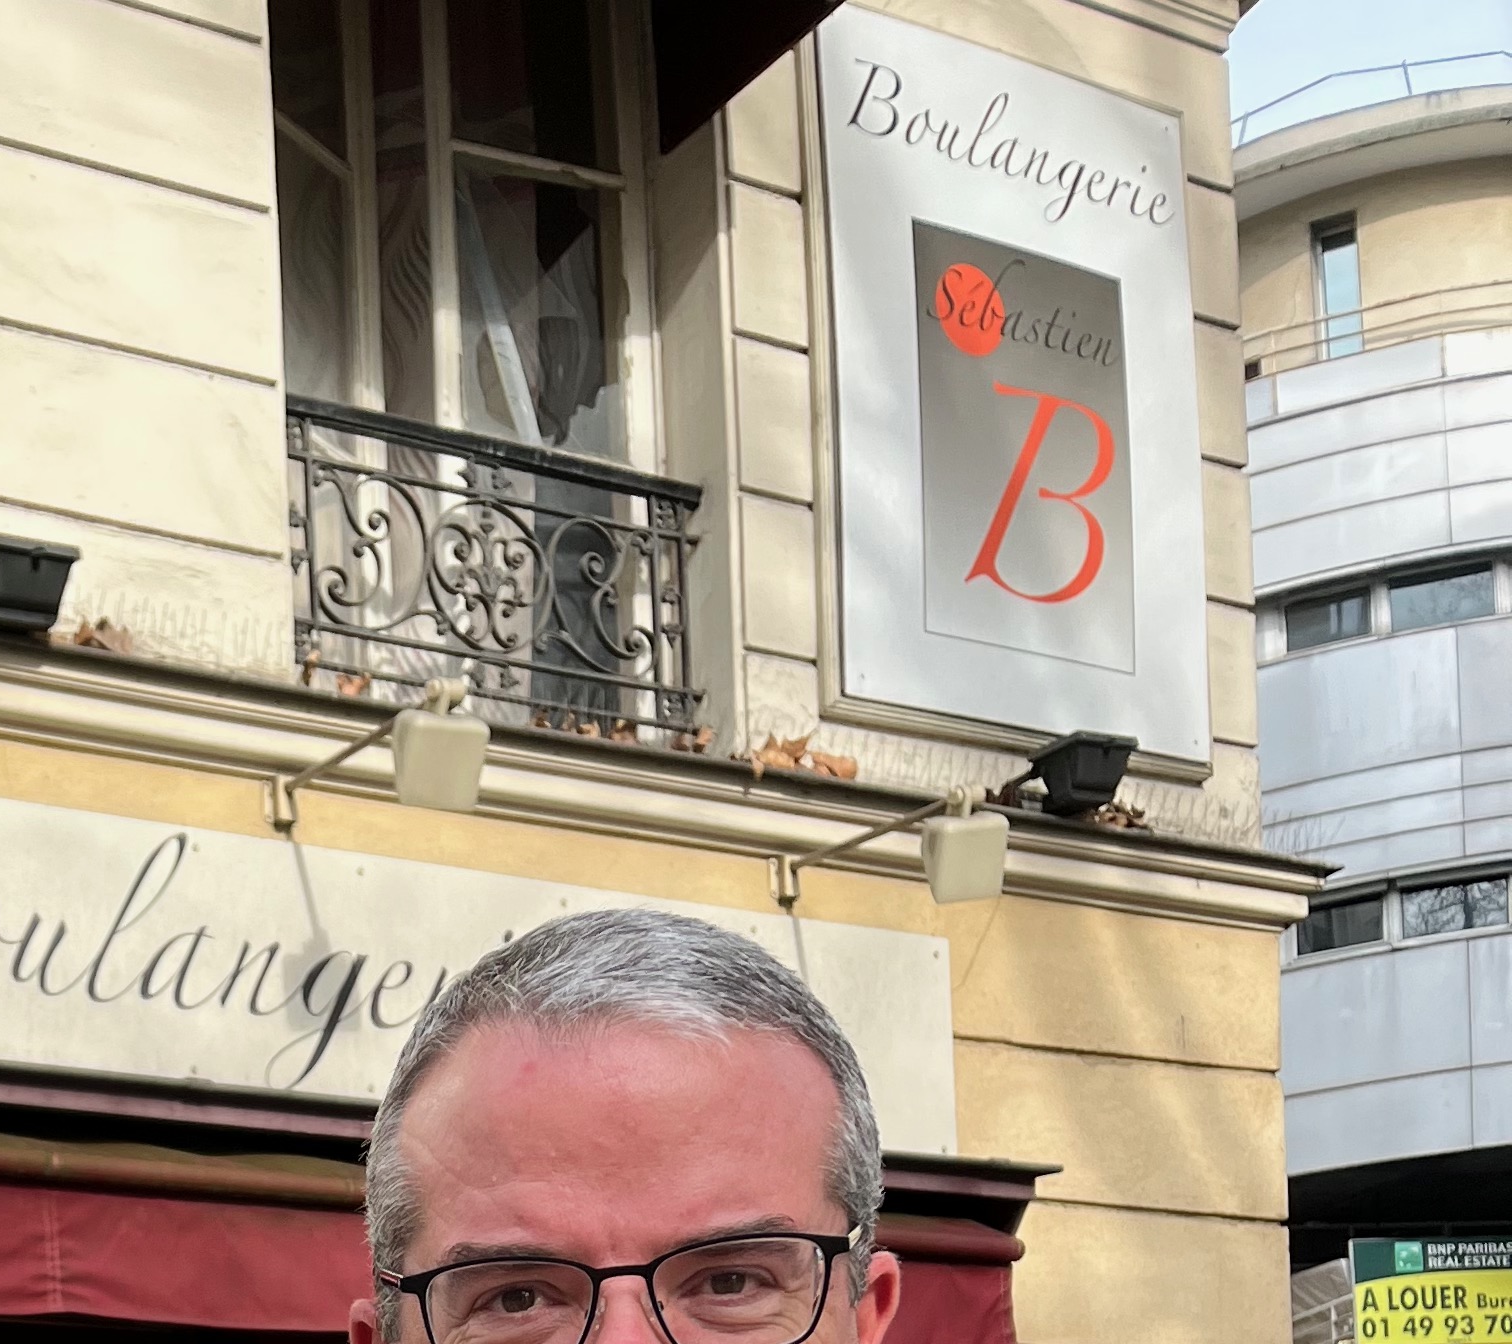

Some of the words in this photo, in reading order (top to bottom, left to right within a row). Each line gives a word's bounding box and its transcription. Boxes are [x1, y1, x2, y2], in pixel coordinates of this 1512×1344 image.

[846, 56, 1175, 227] Boulangerie
[925, 258, 1119, 367] Sébastien
[964, 380, 1116, 605] B
[1427, 1242, 1456, 1256] BNP
[1427, 1255, 1462, 1268] REAL
[1464, 1254, 1511, 1268] ESTATE
[1361, 1287, 1379, 1312] A
[1387, 1285, 1468, 1311] LOUER
[1361, 1316, 1390, 1338] 01
[1402, 1315, 1434, 1337] 49
[1443, 1314, 1475, 1336] 93
[1484, 1313, 1512, 1335] 70
